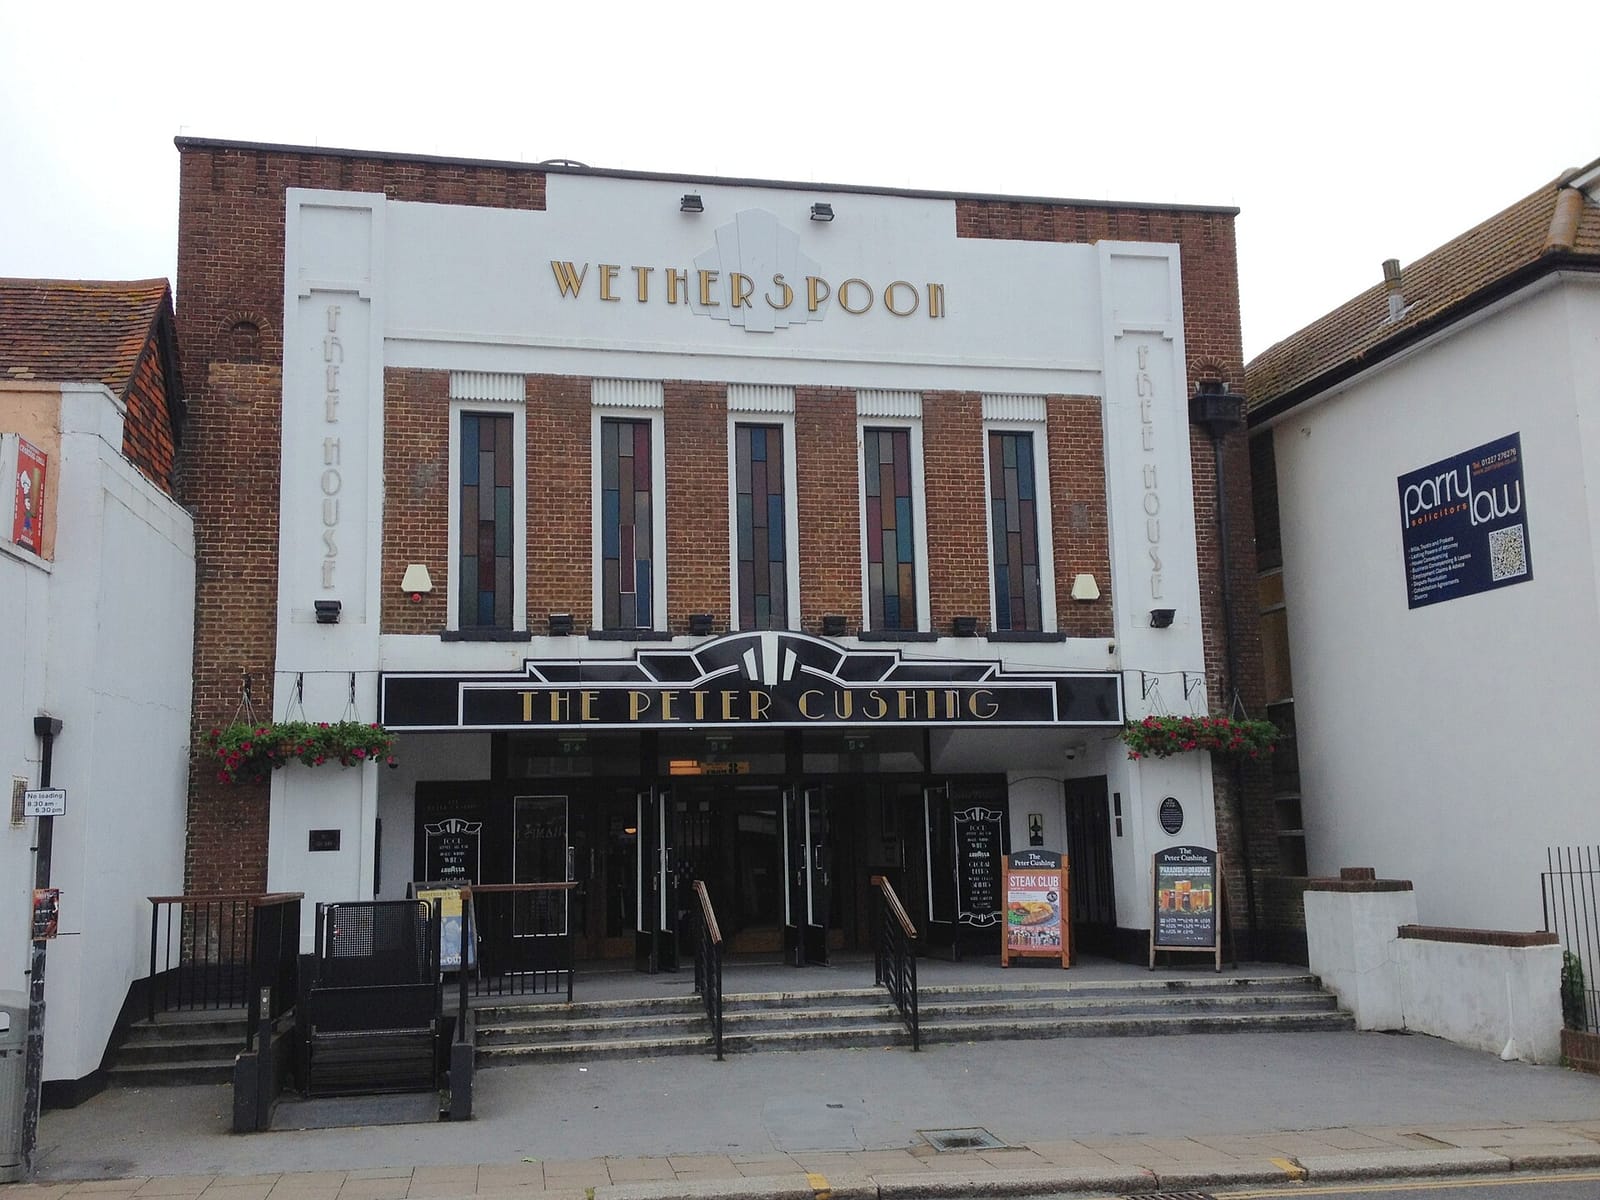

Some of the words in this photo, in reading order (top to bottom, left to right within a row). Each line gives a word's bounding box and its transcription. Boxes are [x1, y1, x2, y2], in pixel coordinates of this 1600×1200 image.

[550, 260, 946, 318] WETHERSPOON
[323, 304, 344, 423] FREE
[1137, 345, 1154, 451] FREE
[321, 436, 342, 590] HOUSE
[1404, 465, 1472, 528] parry
[1467, 479, 1521, 526] law
[1411, 503, 1468, 527] solicitors
[1143, 463, 1163, 600] HOUSE
[518, 691, 601, 721] THE
[628, 690, 772, 721] PETER
[798, 689, 1000, 720] CUSHING
[38, 792, 63, 800] loading
[1030, 860, 1056, 868] Cushing
[1181, 854, 1208, 863] Cushing
[1010, 876, 1036, 887] STEAK
[1038, 876, 1059, 887] CLUB
